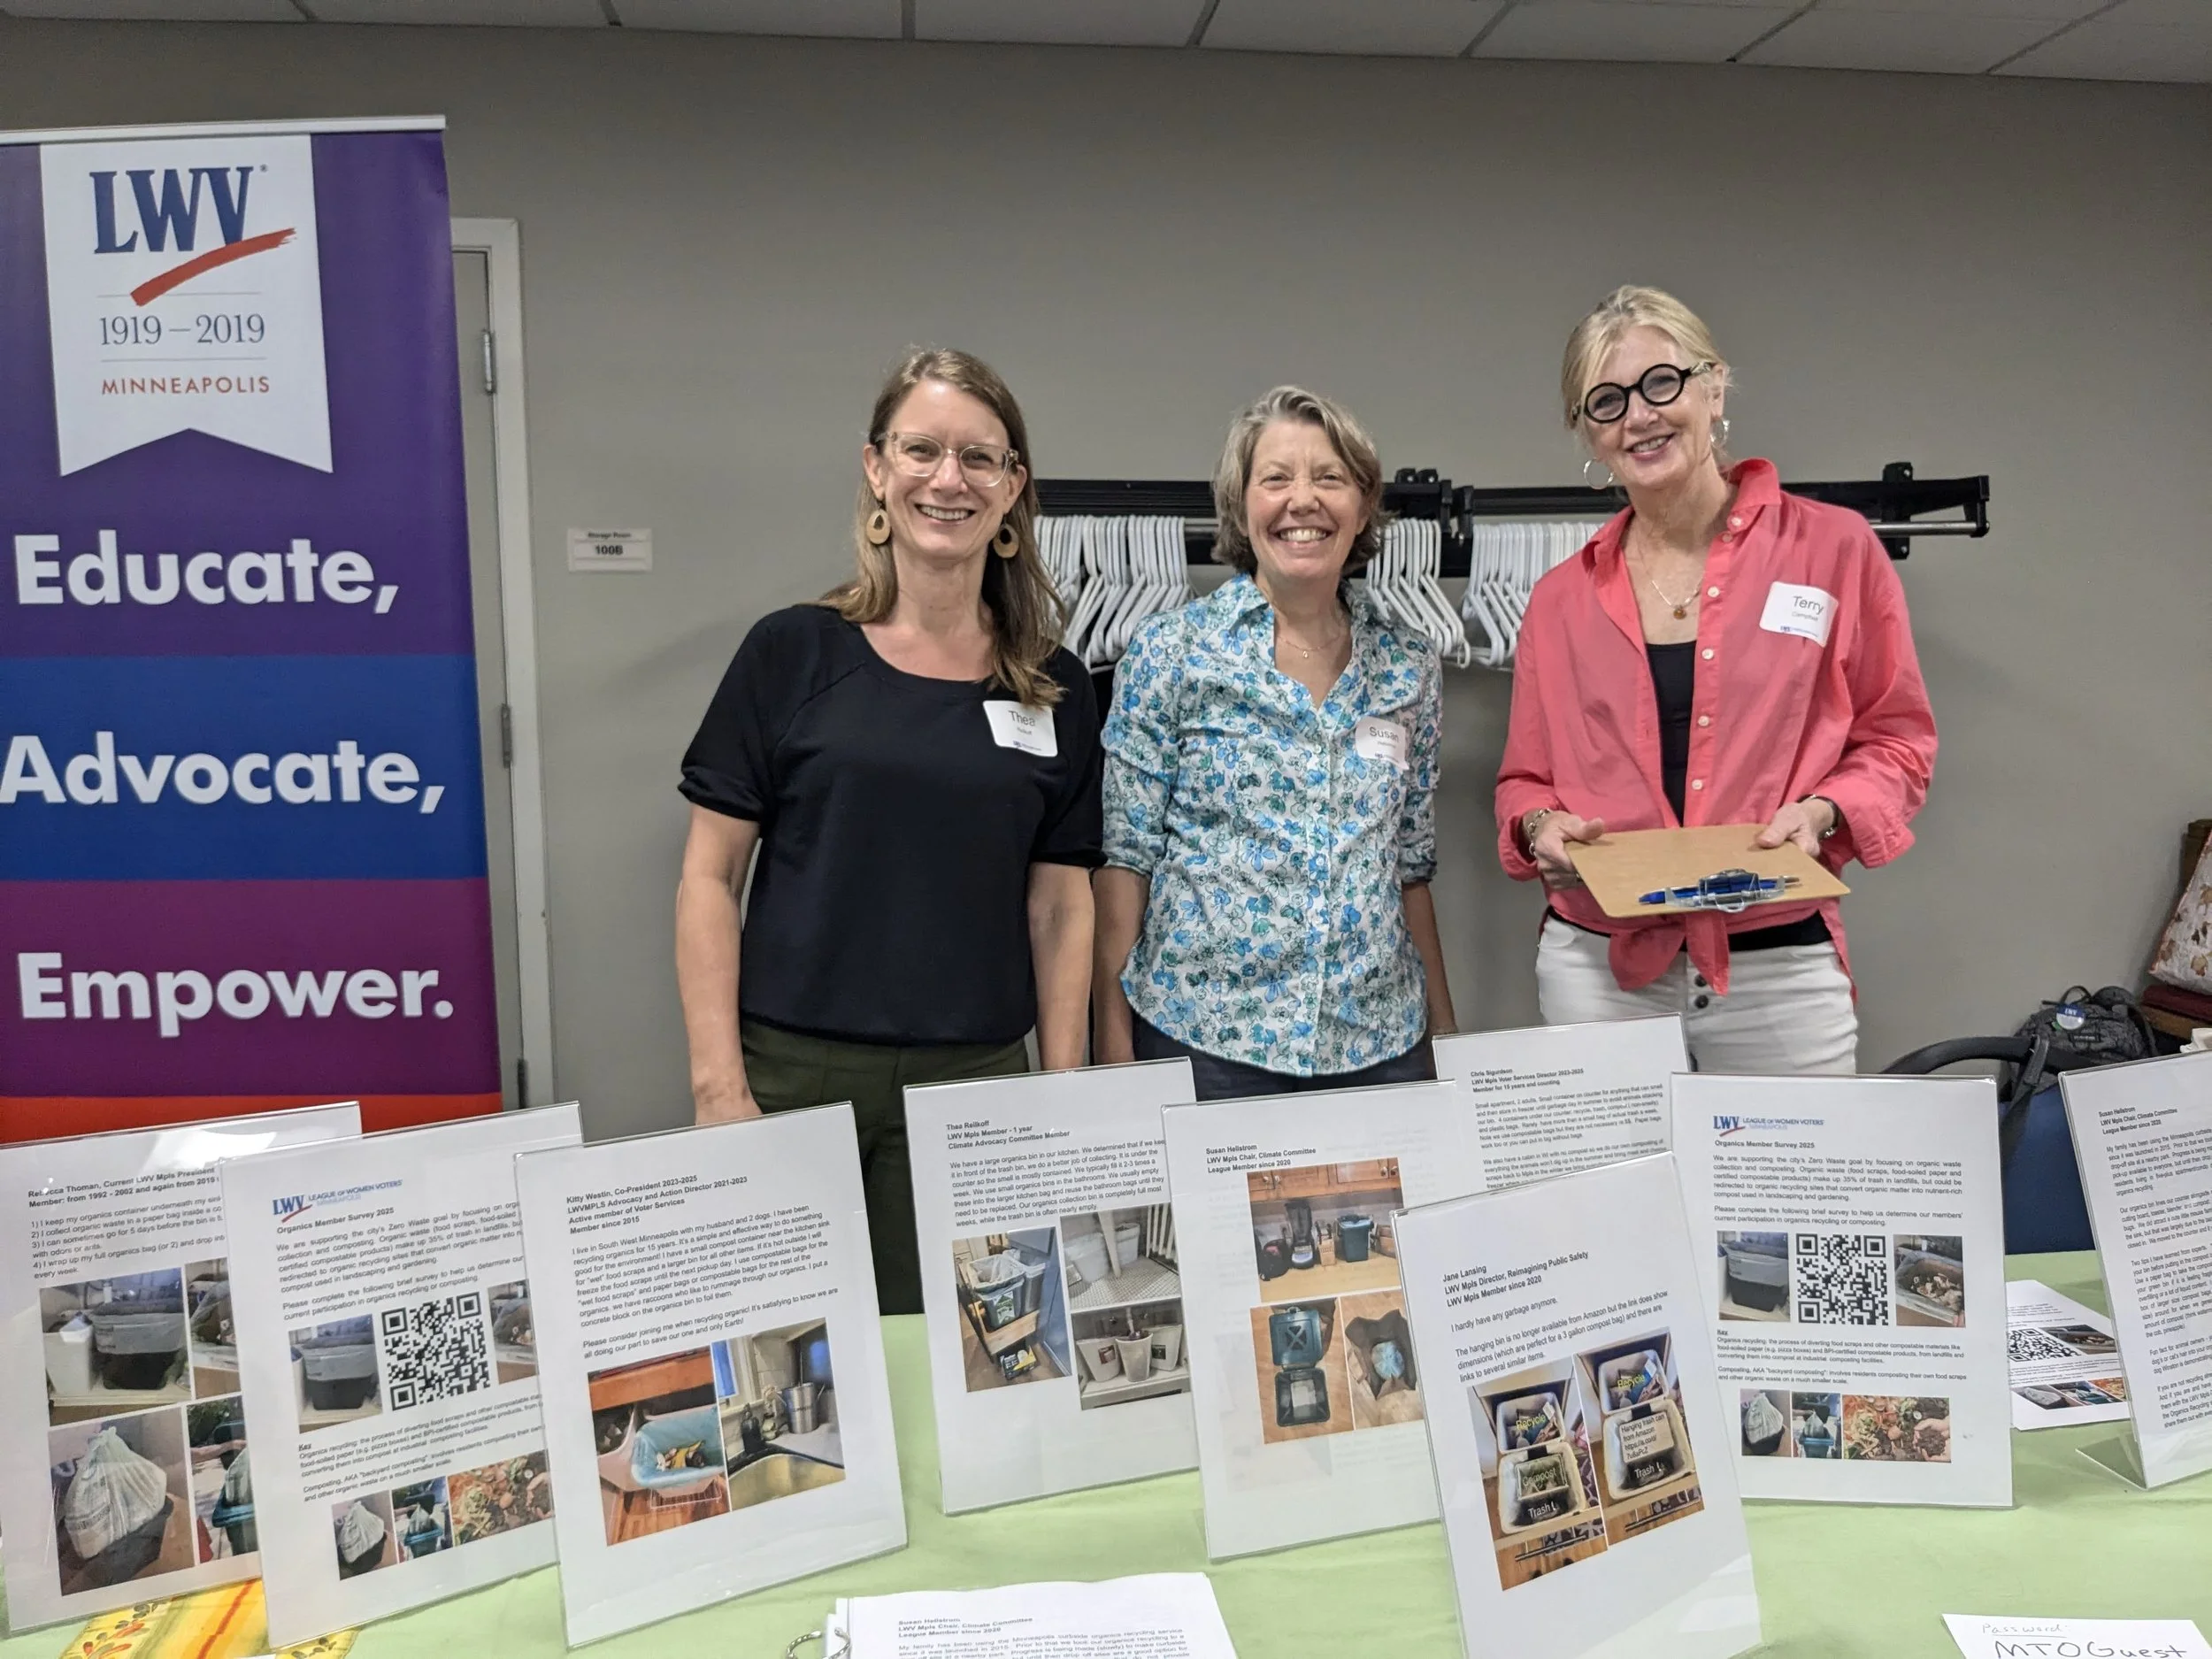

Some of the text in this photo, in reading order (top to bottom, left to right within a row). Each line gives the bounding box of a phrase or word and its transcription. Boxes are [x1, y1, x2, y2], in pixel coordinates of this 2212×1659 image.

[89, 165, 255, 254] LWV
[102, 376, 270, 396] MINNEAPOLIS
[14, 529, 399, 614] Educate,
[1793, 595, 1824, 615] Terry
[1008, 710, 1035, 726] Thea
[1369, 726, 1399, 742] Susan
[0, 731, 446, 814] Advocate,
[18, 952, 454, 1038] Empower.
[1713, 1116, 1740, 1129] LWV
[975, 1138, 1007, 1147] Advocacy
[1008, 1134, 1043, 1143] Committee
[1044, 1131, 1070, 1139] Member
[29, 1198, 65, 1207] Member:
[88, 1191, 107, 1200] 1992
[114, 1187, 134, 1196] 2002
[152, 1183, 175, 1192] again
[568, 1176, 747, 1214] LWVMPLS Advocacy and Action Director 2021-2023
[585, 1191, 613, 1200] Westin,
[614, 1182, 661, 1195] Co-President
[662, 1175, 697, 1187] 2023-2025
[273, 1195, 305, 1215] LWV
[569, 1215, 592, 1224] Active
[594, 1210, 624, 1220] member
[634, 1204, 653, 1212] Voter
[654, 1199, 685, 1209] Services
[277, 1207, 394, 1234] Organics Member Survey 2025
[570, 1215, 640, 1234] Member since 2015
[1443, 1266, 1487, 1282] Jane Lansing
[1444, 1252, 1588, 1295] LWV Mpls Director, Reimagining Public Safety
[1447, 1275, 1542, 1307] LWV Mpls Member since 2020
[1451, 1298, 1558, 1333] I hardly have any garbage anymore.
[1455, 1348, 1469, 1357] The
[1469, 1341, 1495, 1353] hanging
[1494, 1336, 1506, 1346] bin
[1505, 1334, 1512, 1344] is
[1521, 1327, 1540, 1338] longer
[1542, 1319, 1568, 1332] available
[1568, 1315, 1582, 1324] from
[1583, 1308, 1607, 1320] Amazon
[1607, 1304, 1617, 1313] but
[1627, 1298, 1638, 1307] link
[1638, 1295, 1653, 1304] does
[1653, 1291, 1668, 1300] show
[1516, 1414, 1547, 1430] Recycle
